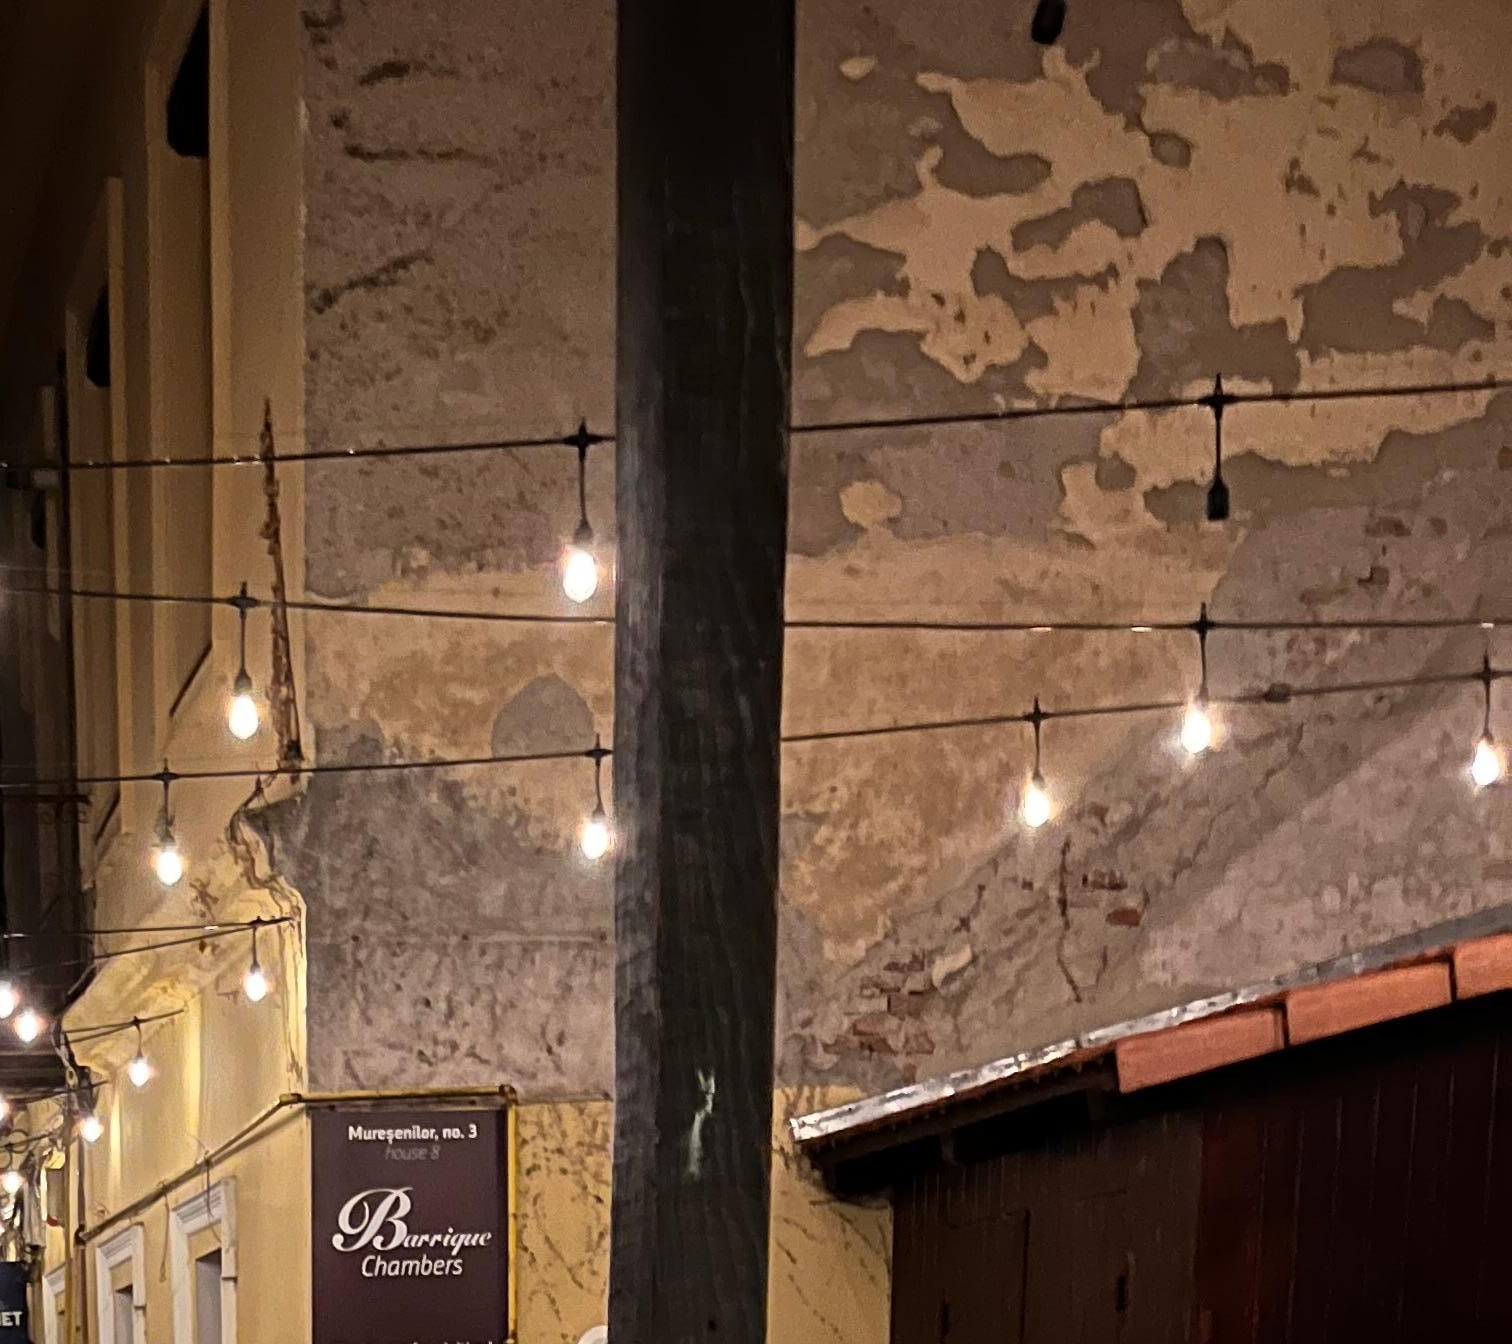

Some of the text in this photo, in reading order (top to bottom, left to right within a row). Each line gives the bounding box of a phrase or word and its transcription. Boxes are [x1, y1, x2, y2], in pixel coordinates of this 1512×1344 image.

[443, 1127, 465, 1139] no.
[468, 1124, 478, 1139] 3
[385, 1145, 428, 1160] house
[332, 1187, 492, 1256] Barrique
[361, 1254, 463, 1277] Chambers
